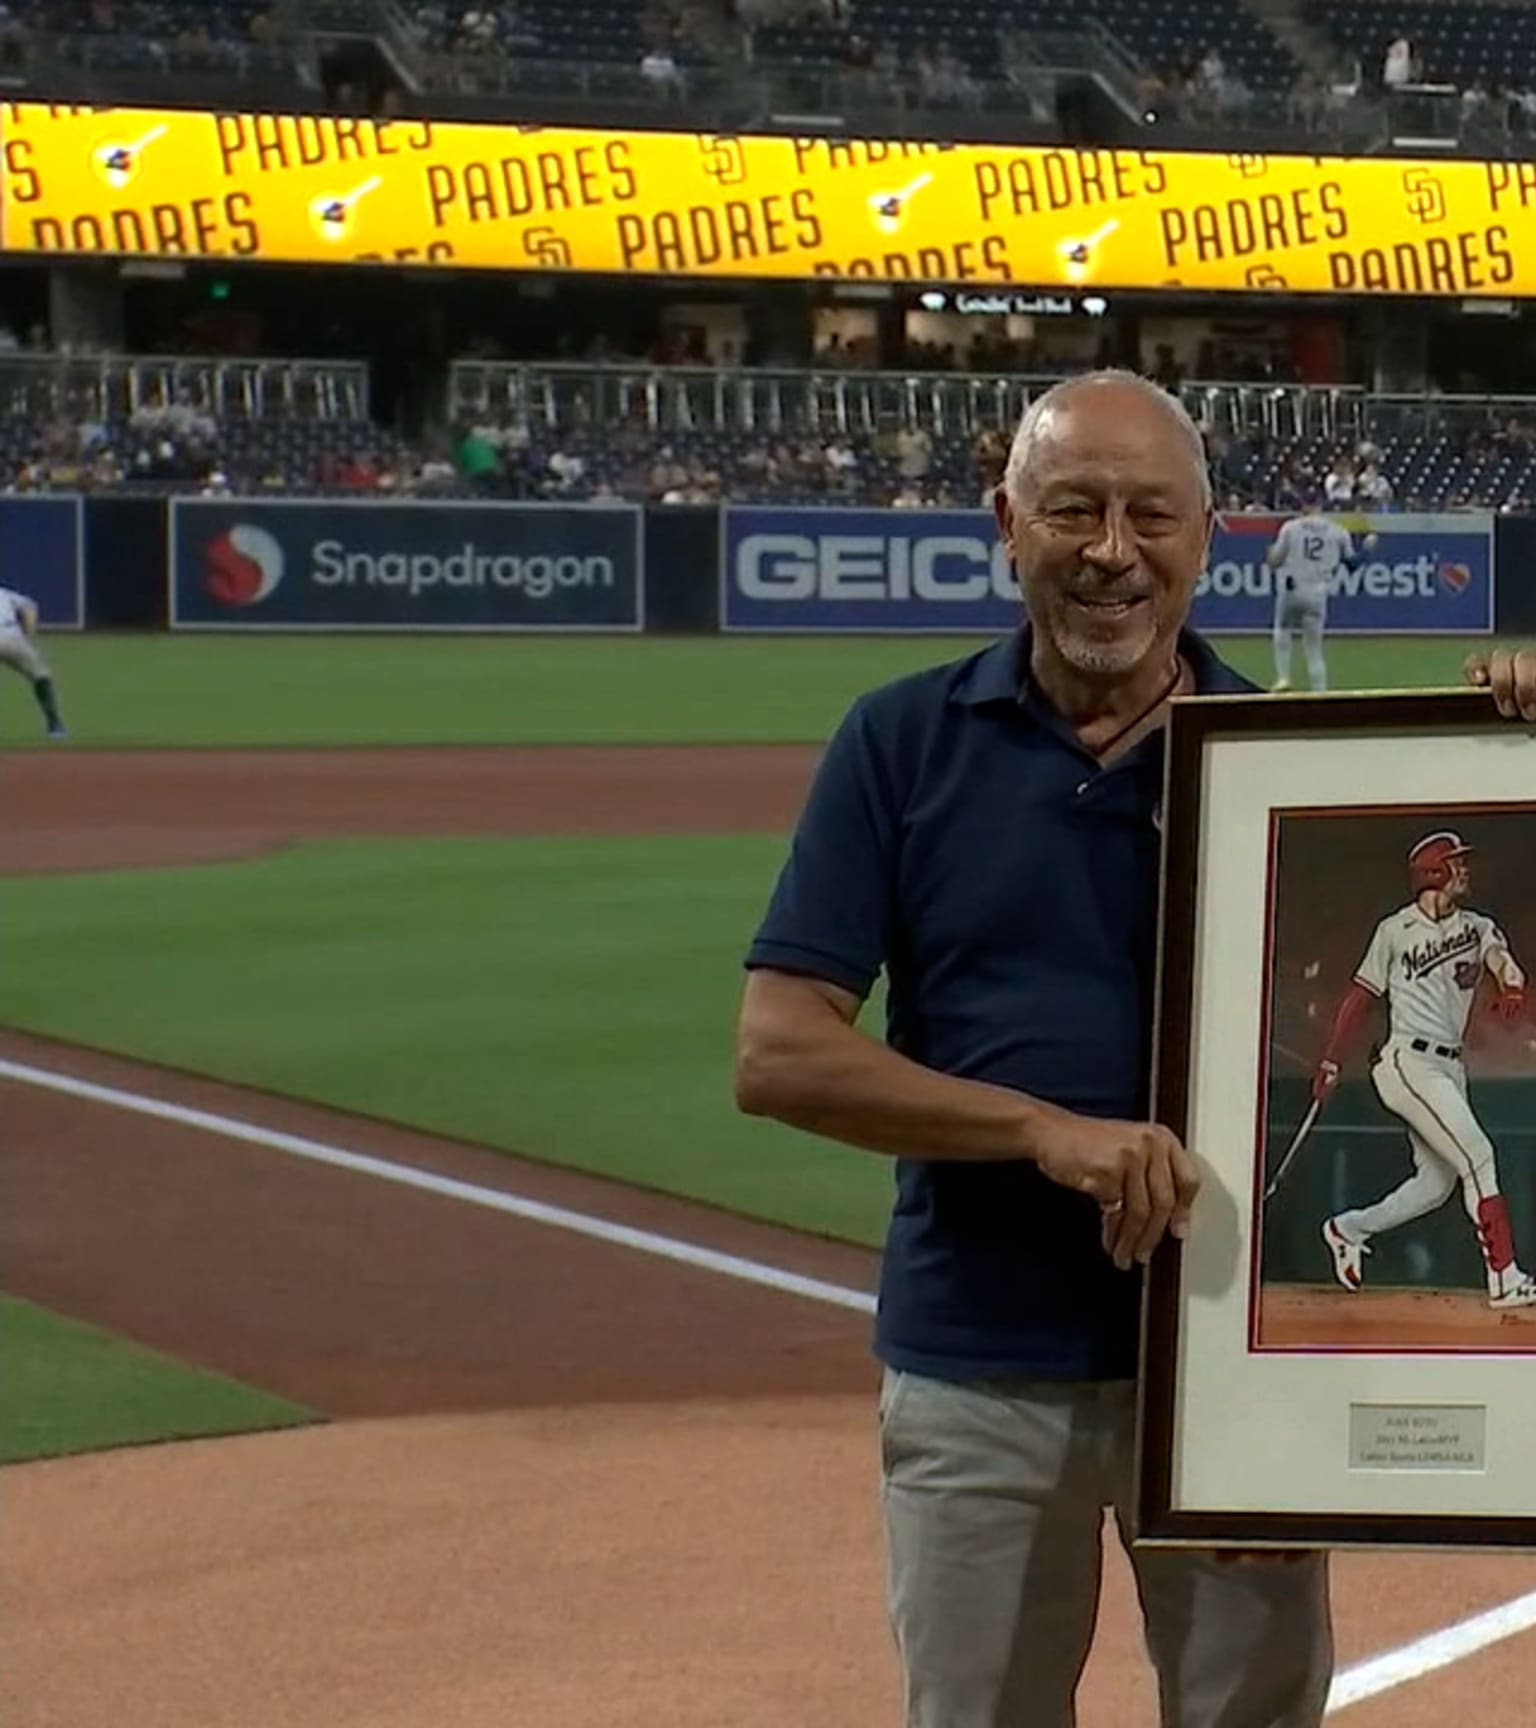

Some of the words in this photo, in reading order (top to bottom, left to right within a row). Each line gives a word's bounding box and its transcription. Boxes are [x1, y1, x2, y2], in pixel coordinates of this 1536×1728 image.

[427, 140, 638, 229] PADRES
[974, 152, 1167, 221] PADRES
[617, 188, 823, 271] PADRES
[1160, 181, 1346, 267] PADRES
[1329, 225, 1515, 292] PADRES
[312, 540, 613, 598] Snapdragon
[1194, 554, 1436, 598] ouwest
[1303, 536, 1325, 560] 12
[1401, 923, 1481, 981] Nationals
